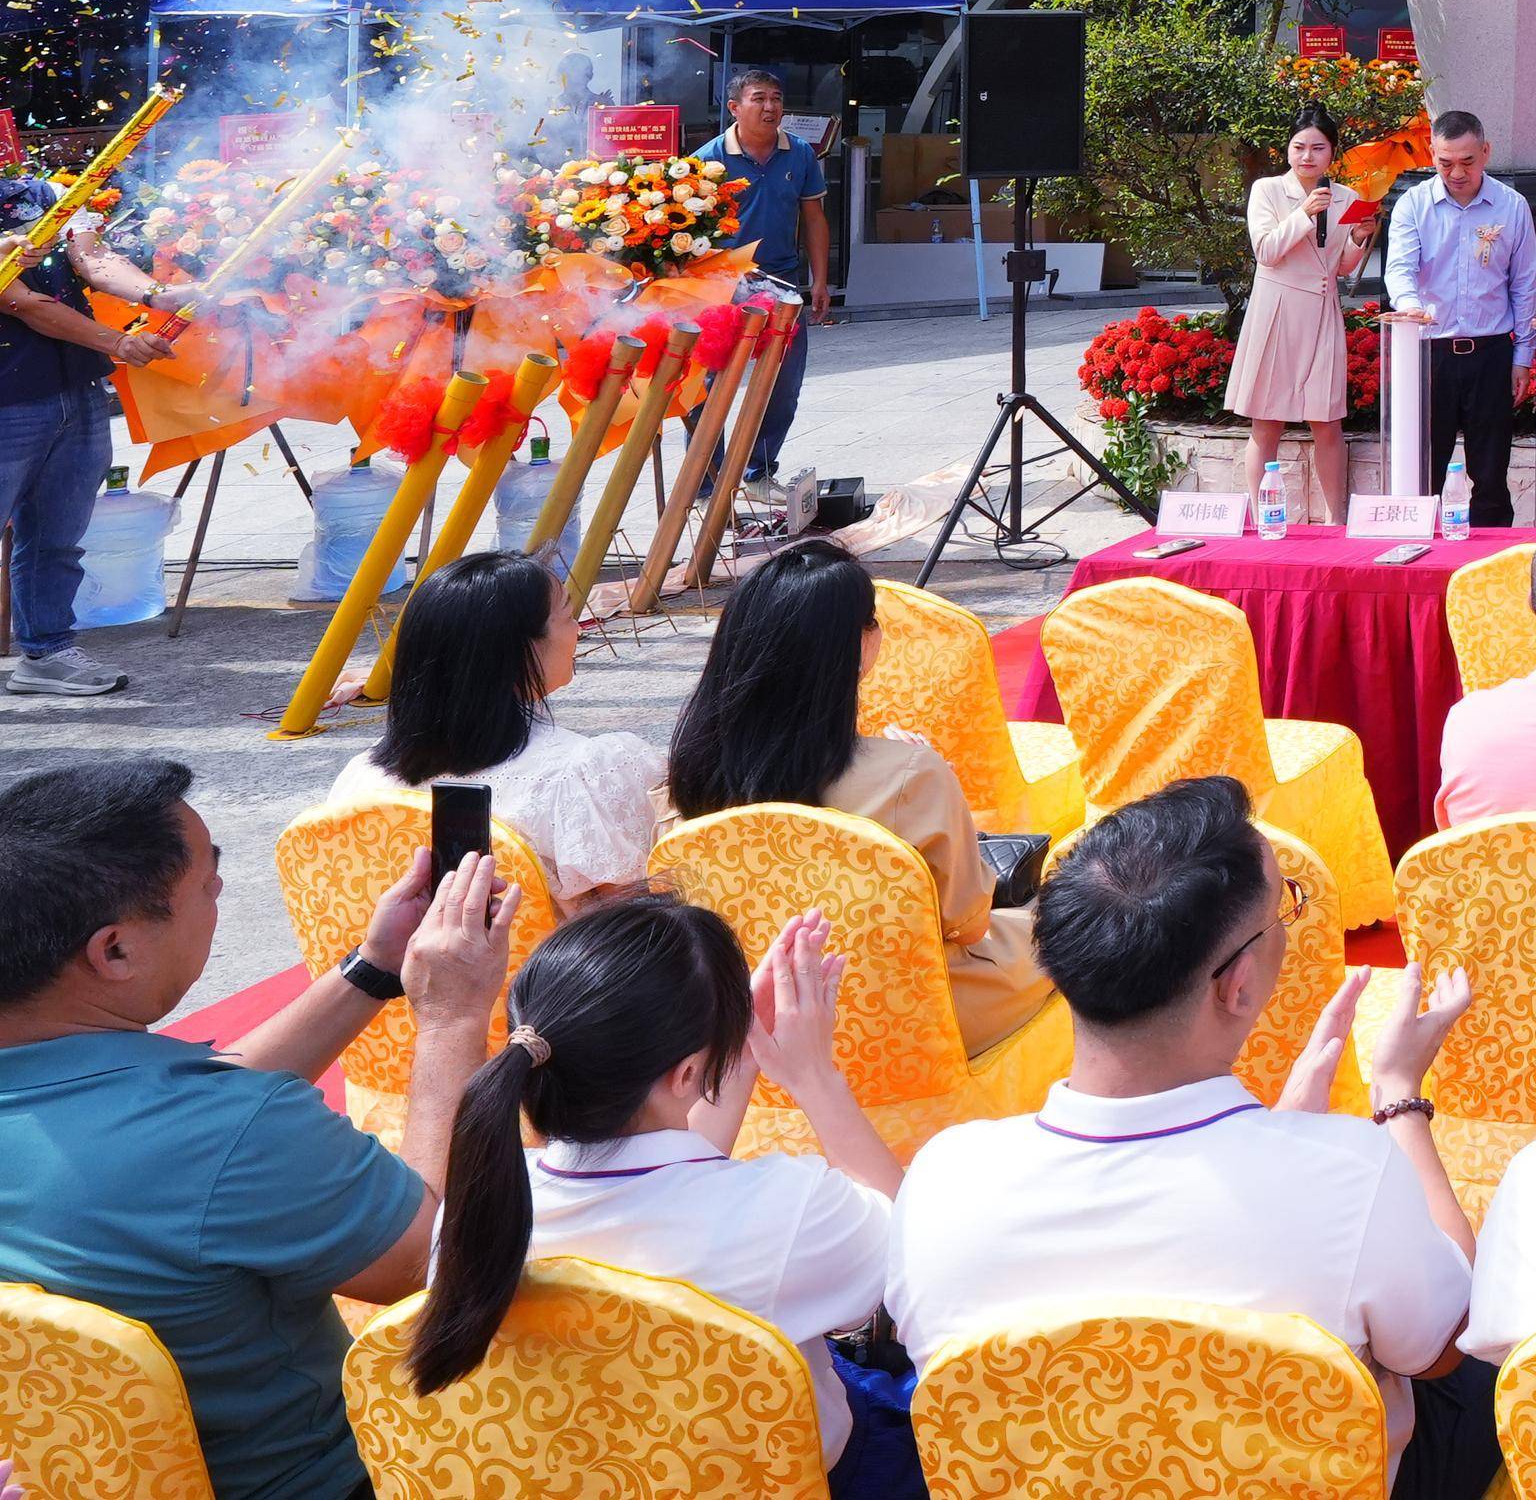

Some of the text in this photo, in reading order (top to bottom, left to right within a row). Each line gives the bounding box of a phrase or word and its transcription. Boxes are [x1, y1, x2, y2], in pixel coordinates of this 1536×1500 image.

[1178, 502, 1229, 521] 邓伟雄
[1368, 502, 1419, 525] 王景民
